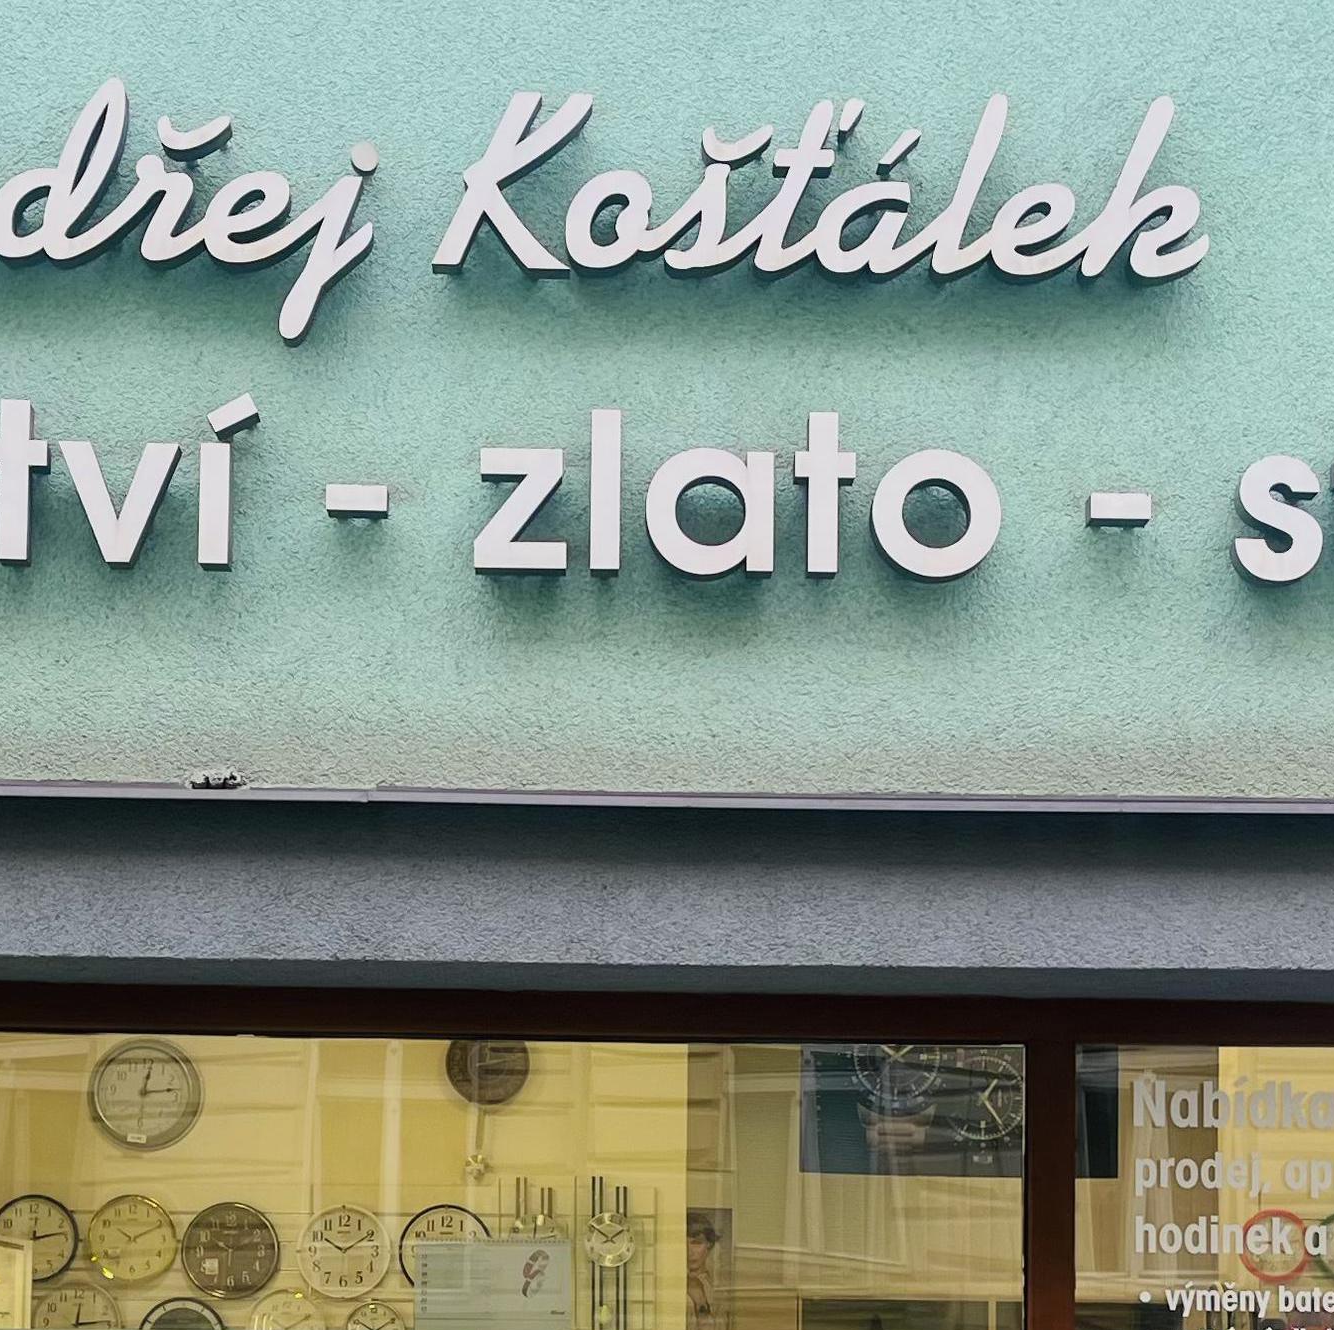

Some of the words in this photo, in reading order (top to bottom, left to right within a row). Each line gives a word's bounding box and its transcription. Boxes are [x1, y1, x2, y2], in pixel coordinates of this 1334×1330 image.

[432, 91, 1210, 281] Košťálek
[326, 484, 389, 518] -
[474, 409, 1002, 580] zlato
[1086, 492, 1151, 527] -
[1135, 1152, 1271, 1197] prodej,
[1135, 1216, 1295, 1256] hodinek
[1304, 1226, 1327, 1257] a
[1165, 1281, 1270, 1317] výměny
